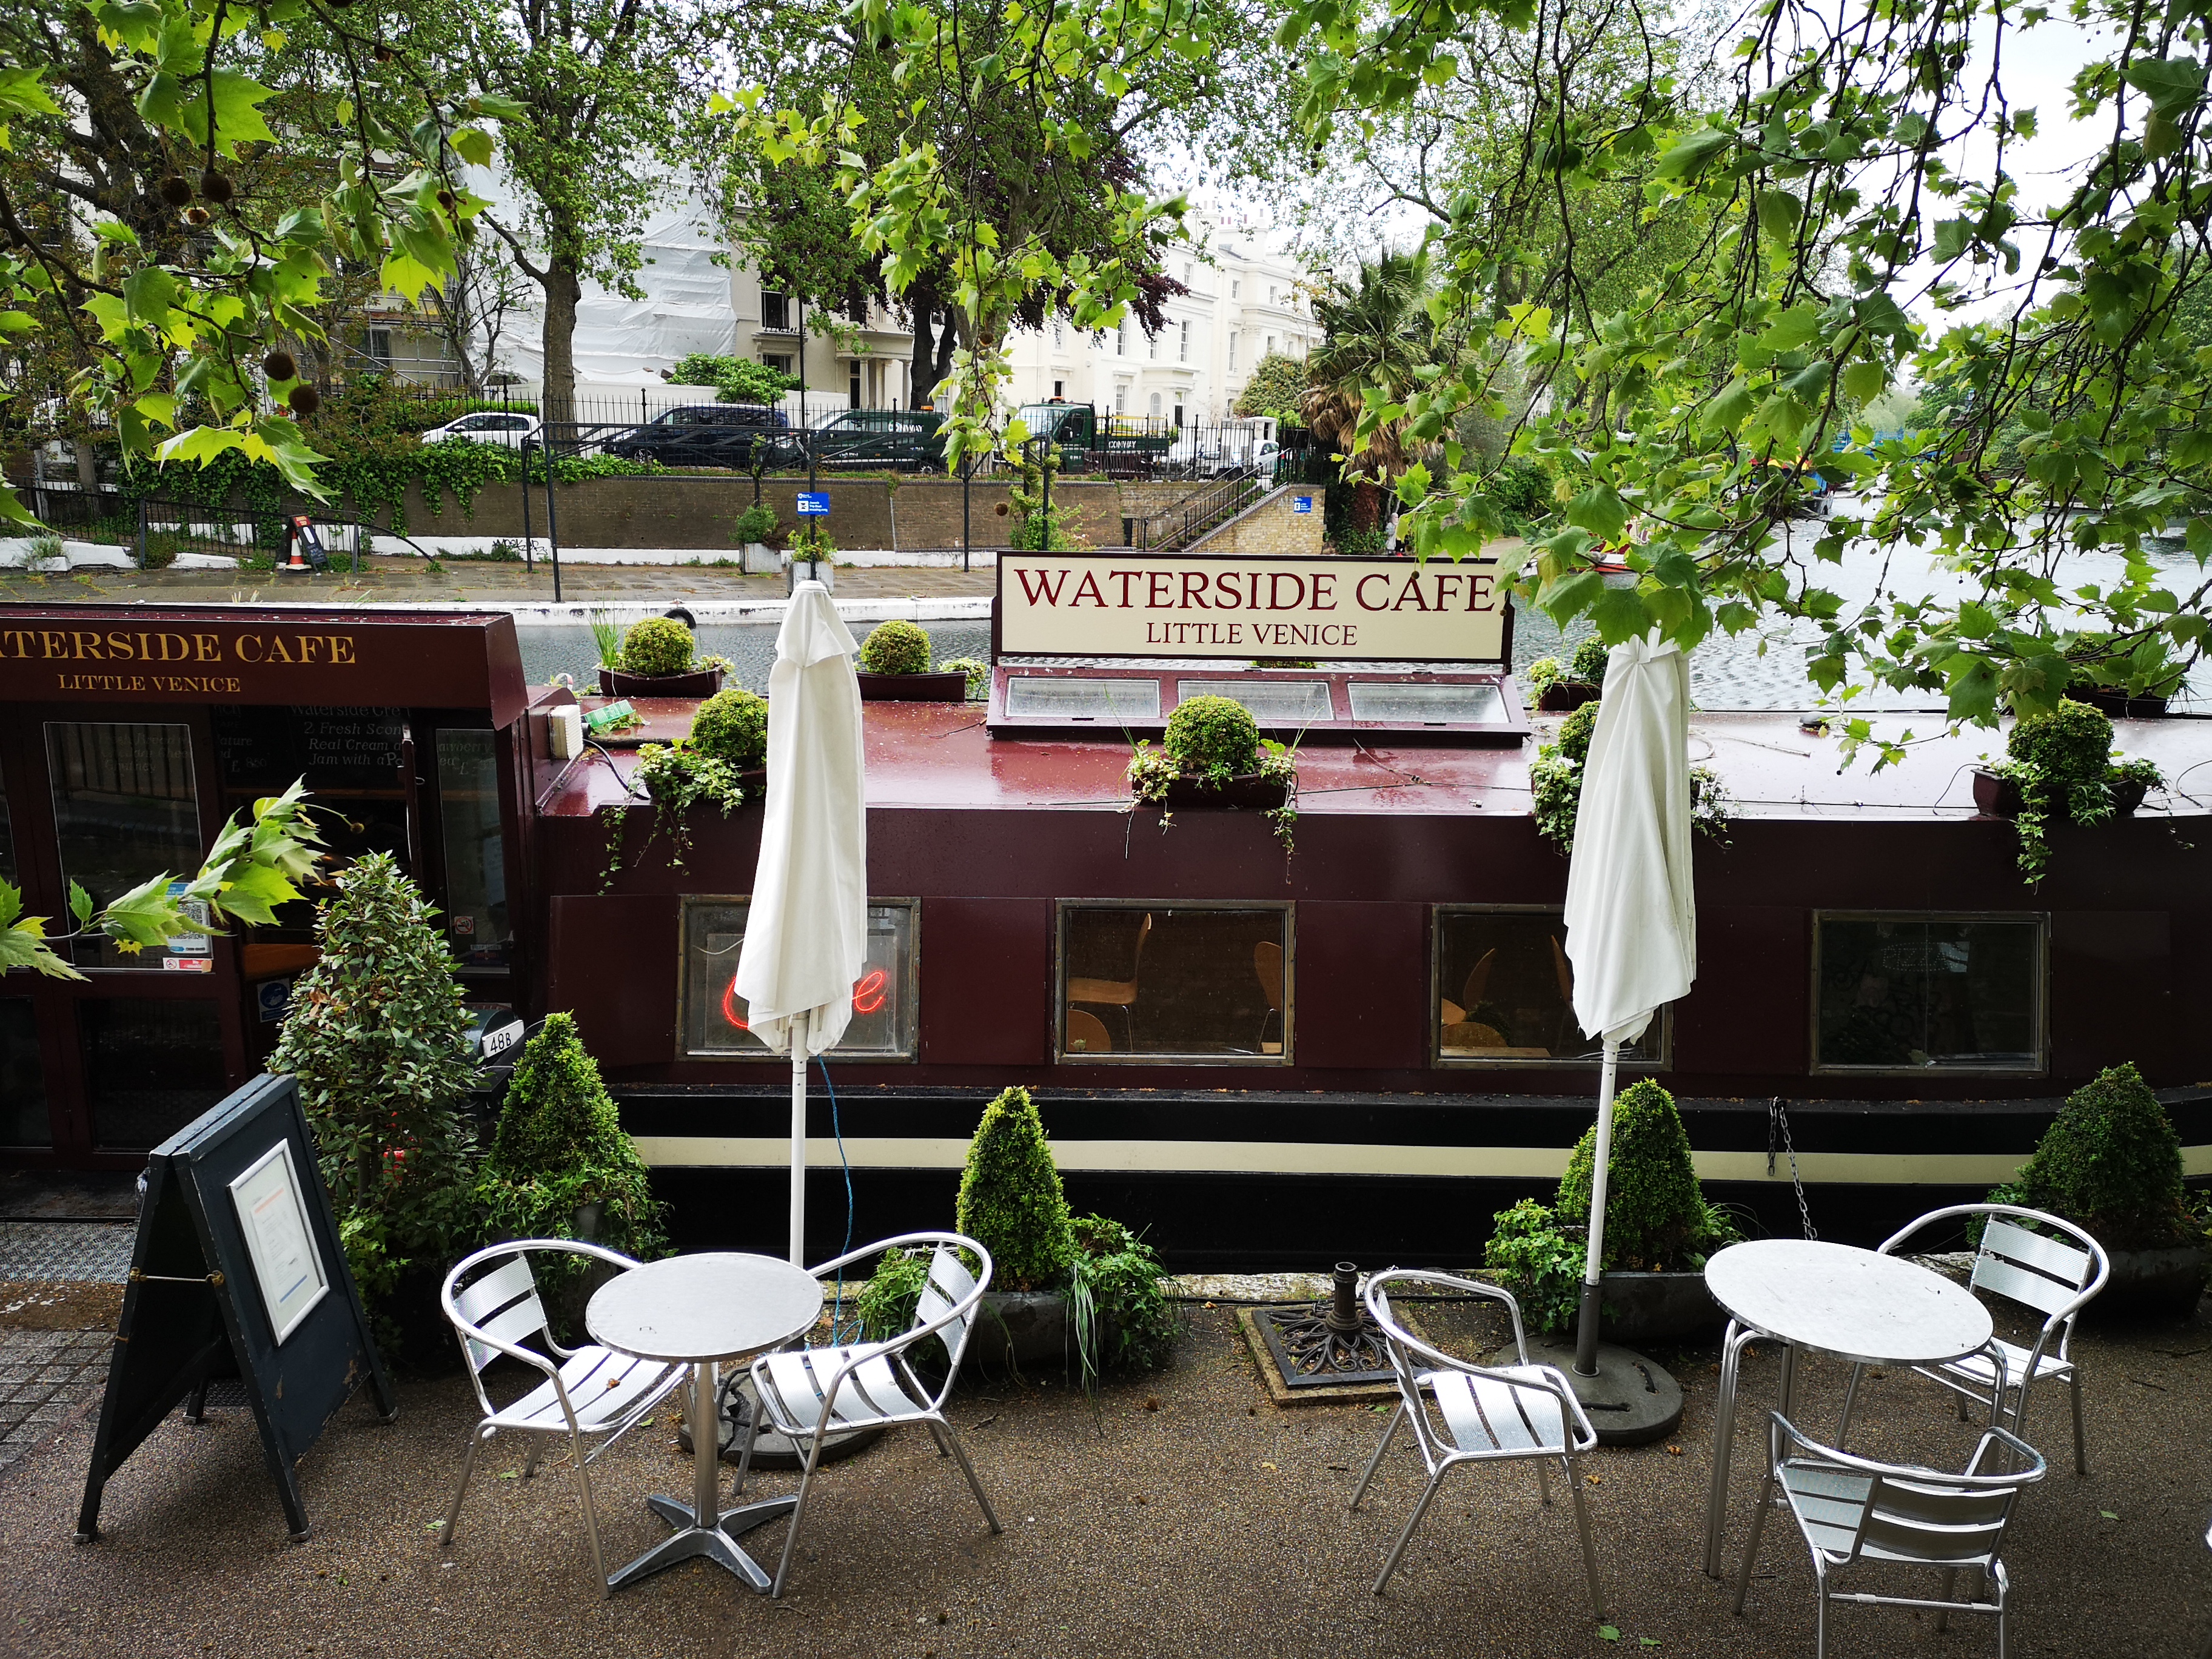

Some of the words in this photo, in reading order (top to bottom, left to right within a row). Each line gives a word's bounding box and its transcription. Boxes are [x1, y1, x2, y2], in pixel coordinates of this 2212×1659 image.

[1013, 569, 1338, 611] WATERSIDE
[1356, 573, 1496, 612] CAFE
[1146, 622, 1243, 645] LITTLE
[1252, 623, 1358, 646] VENICE
[0, 631, 222, 662] TERSIDE
[235, 634, 356, 665] CAFE
[58, 674, 146, 692] LITTLE
[151, 675, 241, 693] VENICE
[304, 721, 314, 734] 2
[319, 722, 361, 735] Fresh
[308, 738, 341, 751] Real
[345, 738, 389, 751] Cream
[309, 752, 339, 766] Jam
[342, 753, 371, 765] with
[490, 1032, 512, 1053] 48B
